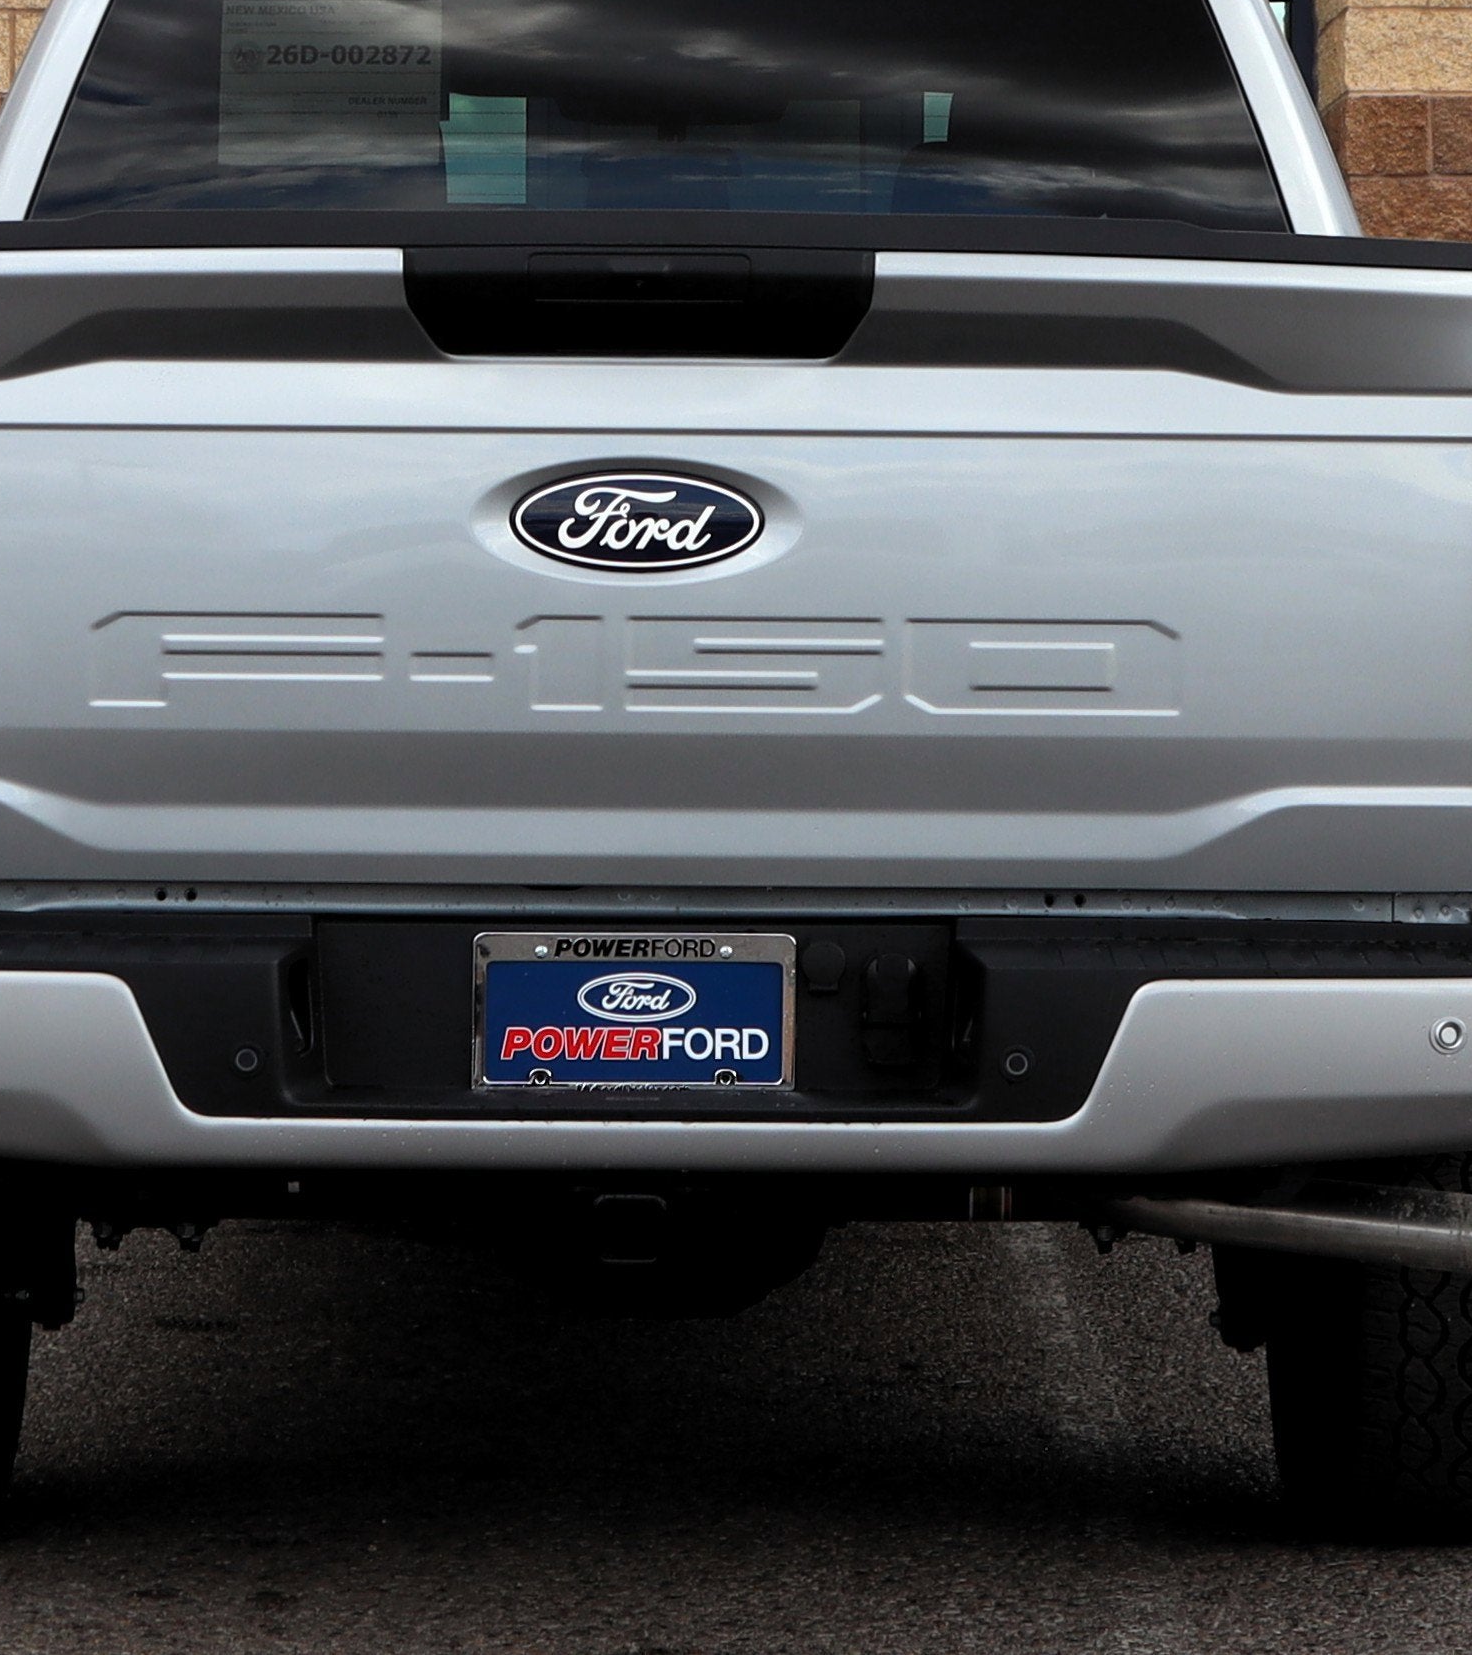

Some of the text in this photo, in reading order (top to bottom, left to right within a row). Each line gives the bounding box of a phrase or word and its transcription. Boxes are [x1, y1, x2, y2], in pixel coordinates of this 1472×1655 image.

[226, 5, 336, 16] NEW MEXICO USA
[267, 45, 432, 66] 26D-002872
[348, 96, 386, 106] DEALER
[558, 487, 712, 553] Ford
[89, 612, 1180, 715] F-150
[553, 938, 717, 958] POWERFORD
[600, 981, 671, 1012] Ford
[500, 1026, 770, 1061] POWERFORD
